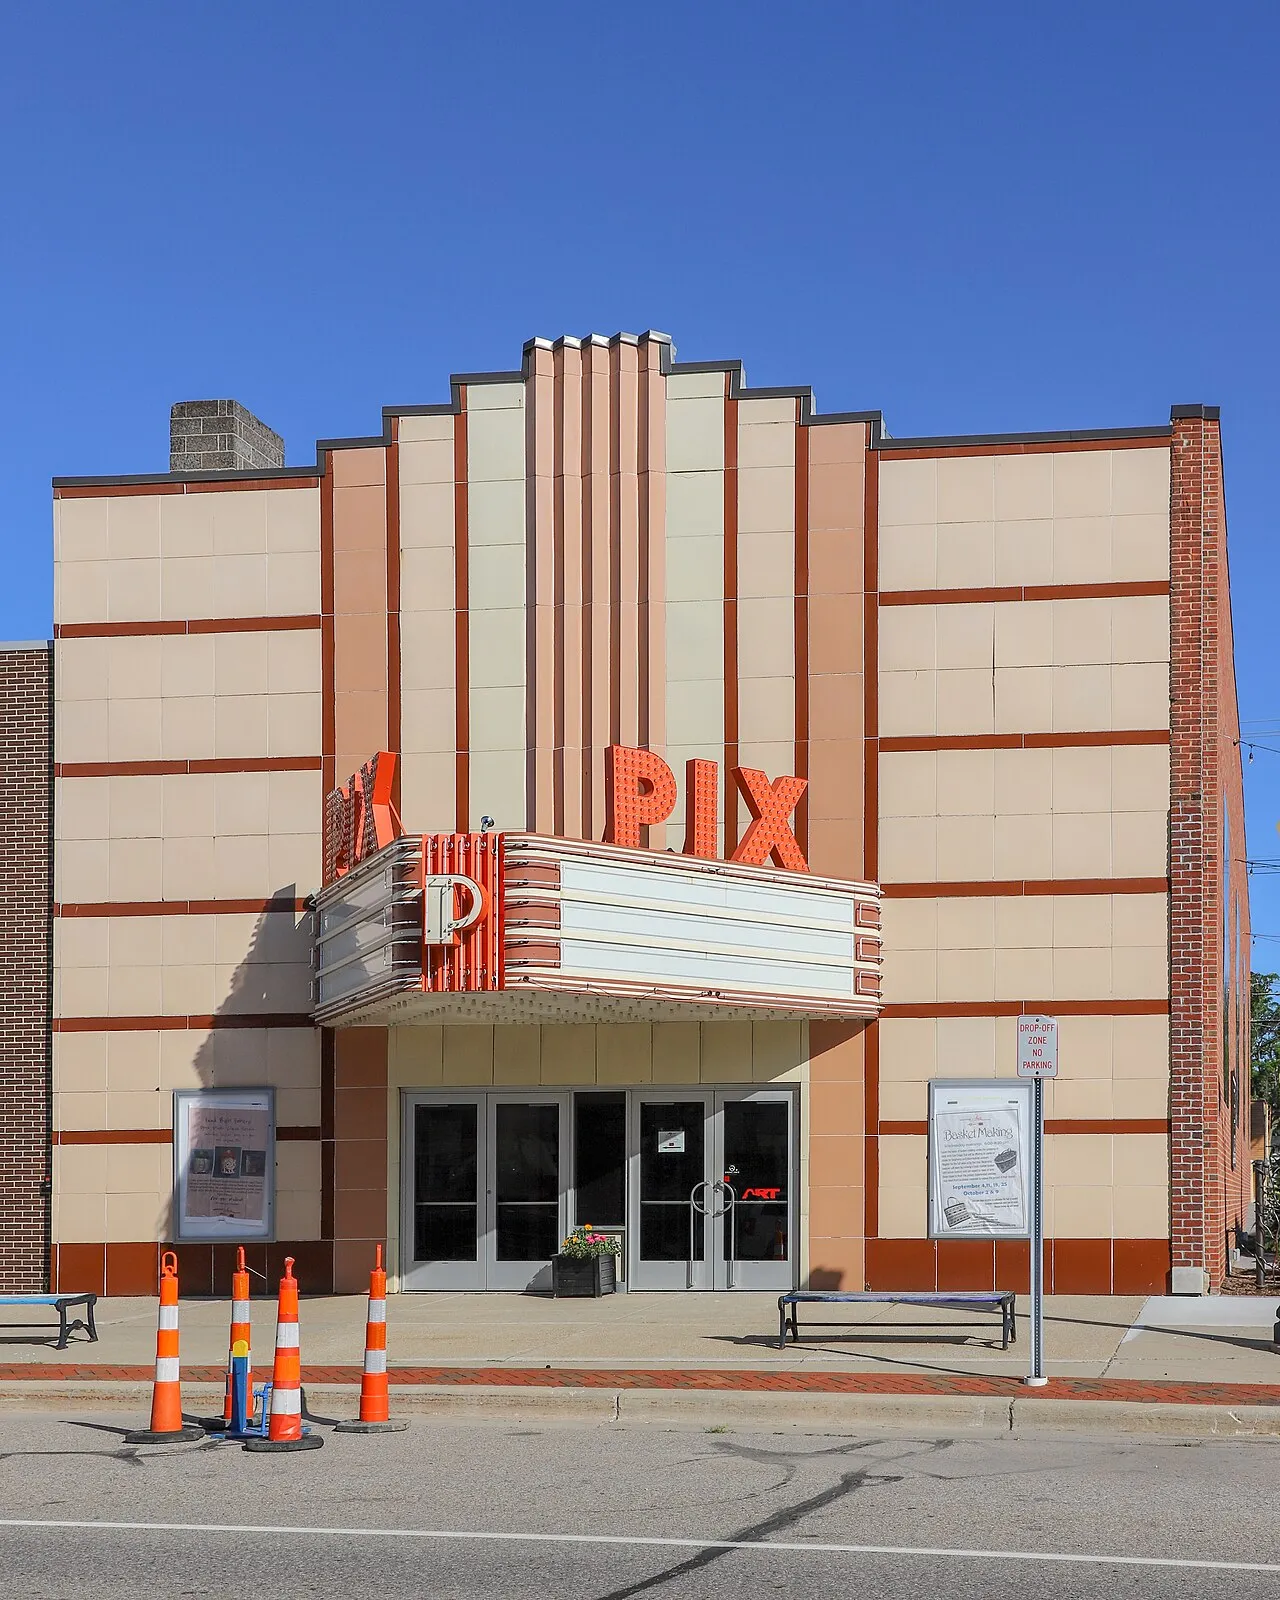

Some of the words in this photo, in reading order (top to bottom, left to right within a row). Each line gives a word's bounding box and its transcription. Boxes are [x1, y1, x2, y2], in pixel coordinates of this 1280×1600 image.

[603, 744, 810, 872] PIX
[425, 874, 489, 946] P
[1020, 1024, 1055, 1032] DROP-OFF
[1028, 1036, 1047, 1045] ZONE
[1032, 1049, 1042, 1057] NO
[1022, 1061, 1052, 1069] PARKING
[944, 1128, 976, 1141] Basket
[977, 1127, 1013, 1139] Making
[742, 1188, 780, 1199] ART
